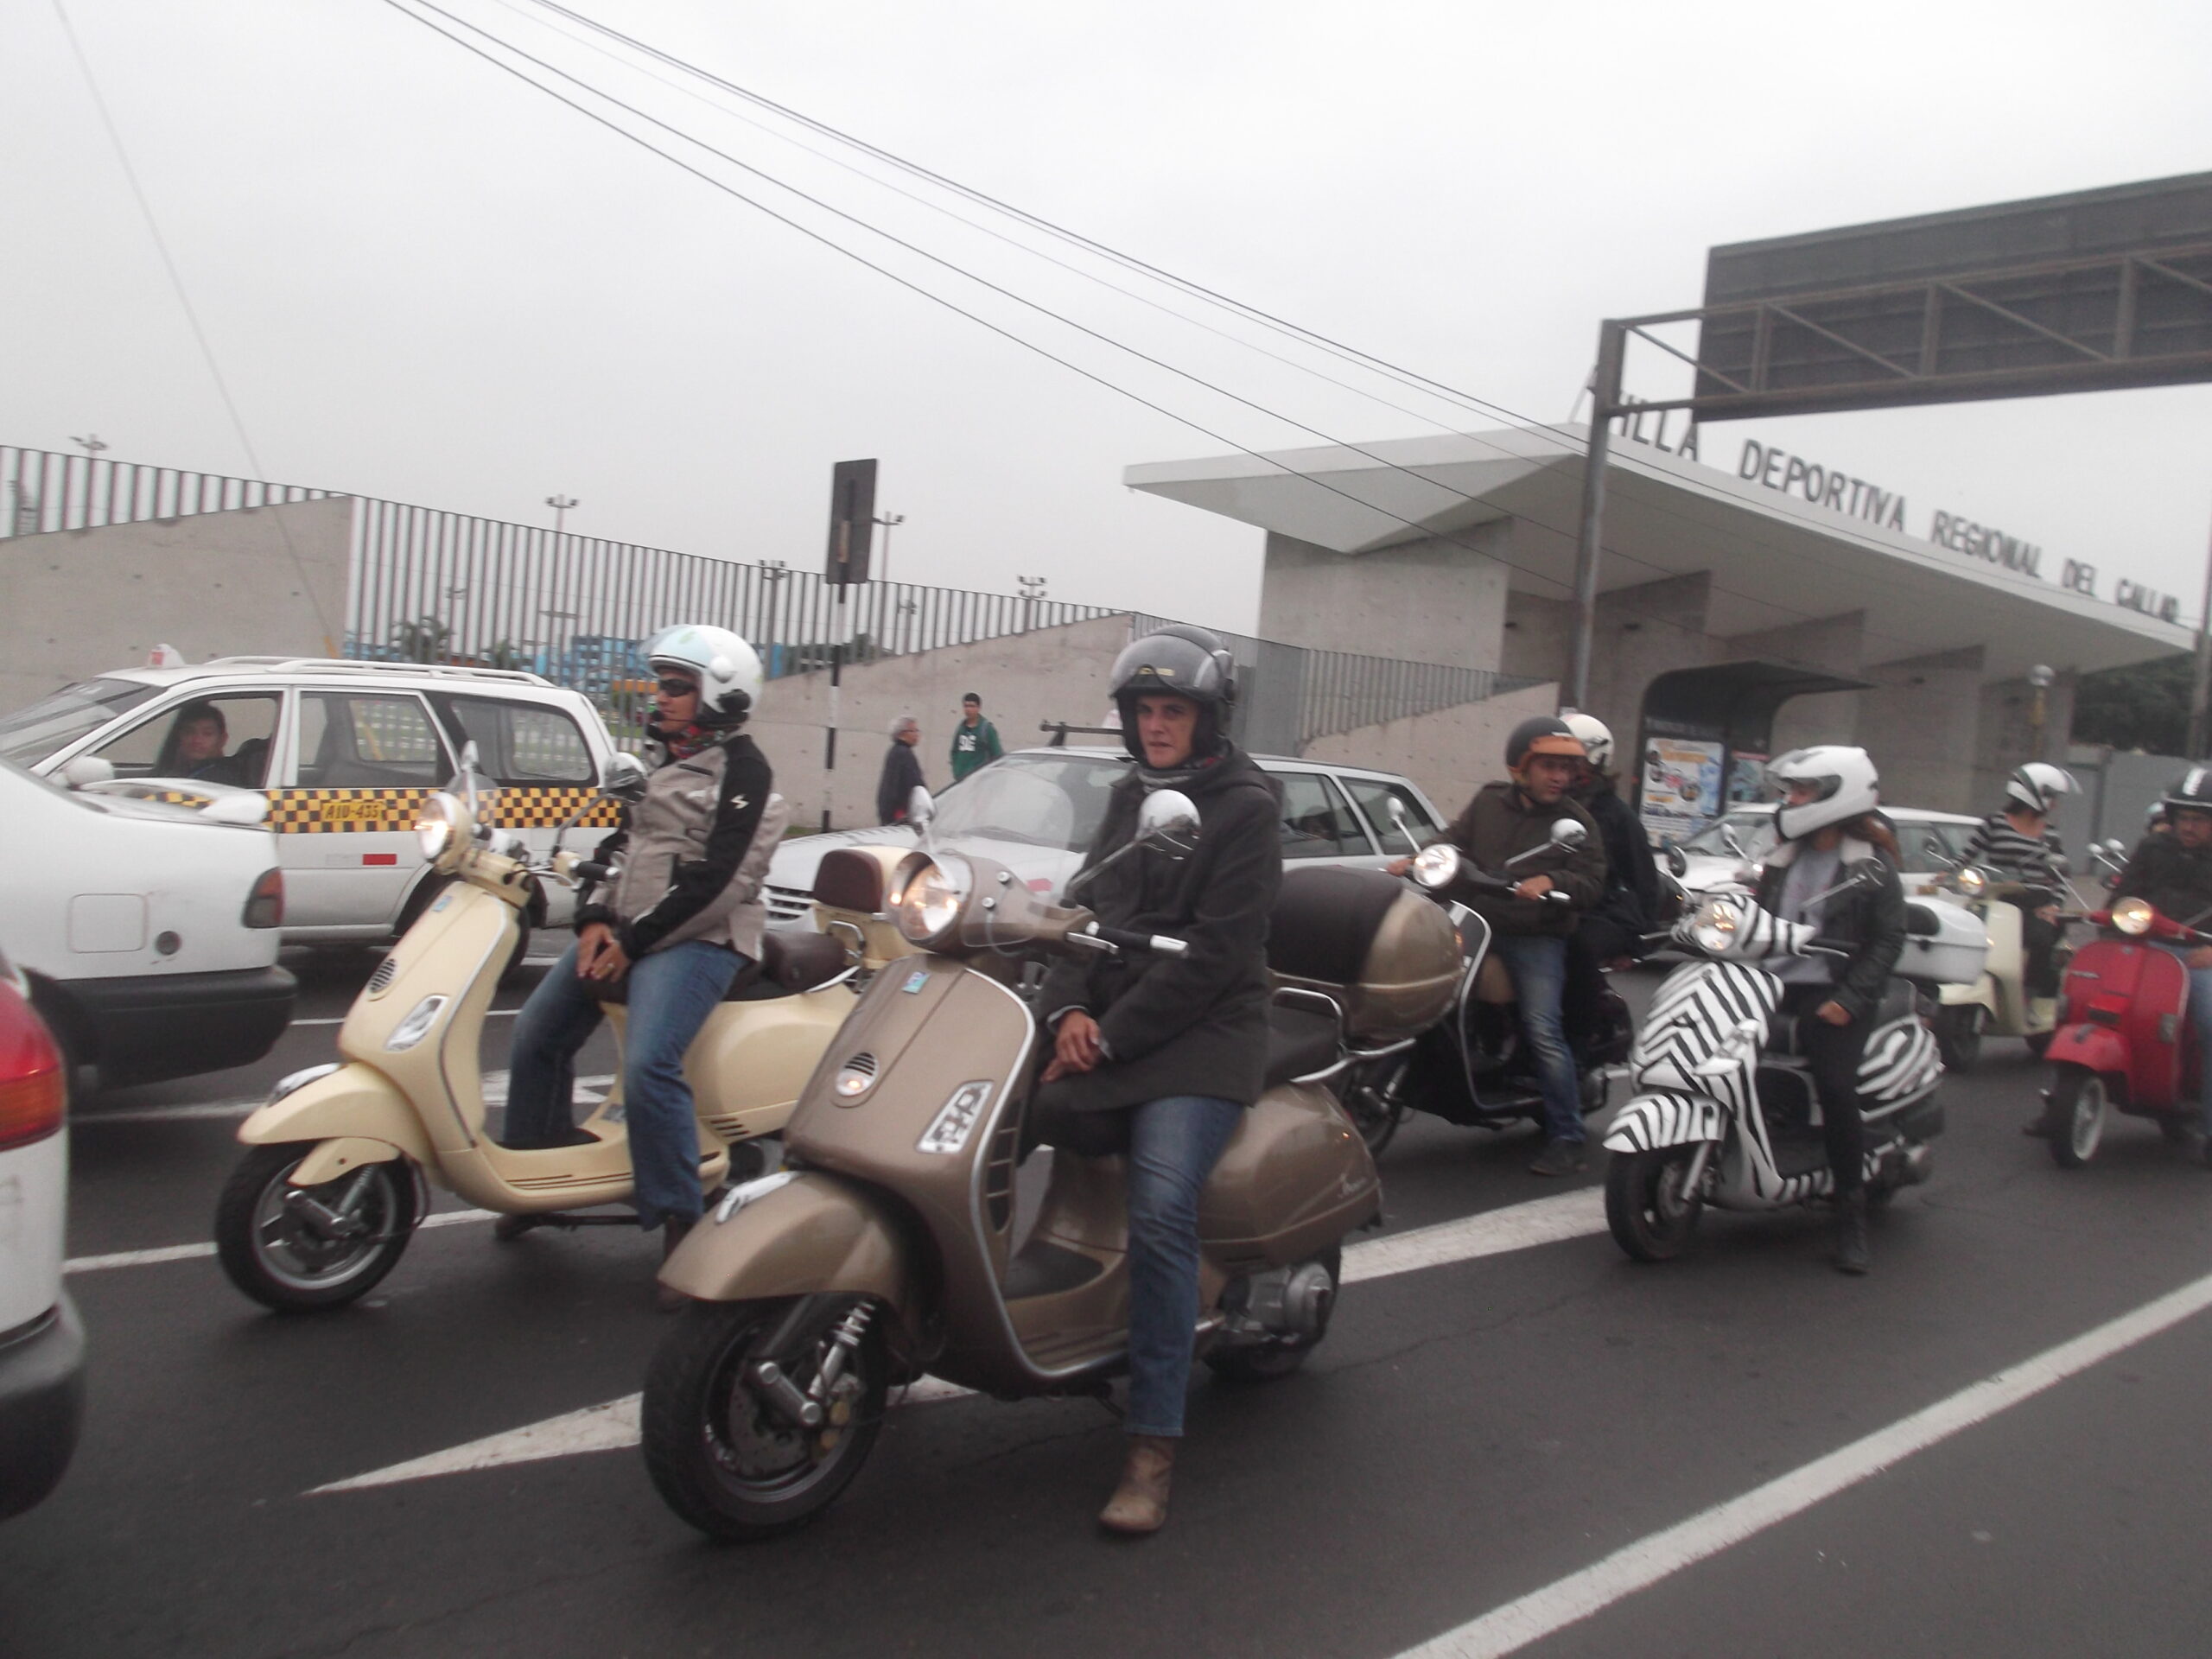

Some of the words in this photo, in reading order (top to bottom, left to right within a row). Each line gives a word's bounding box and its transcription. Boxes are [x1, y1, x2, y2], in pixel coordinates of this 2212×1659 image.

[1621, 394, 1699, 462] ILLA
[1738, 438, 1906, 532] DEPORTIVA
[1930, 508, 2043, 579] REGIONAL
[2062, 557, 2097, 597] DEL
